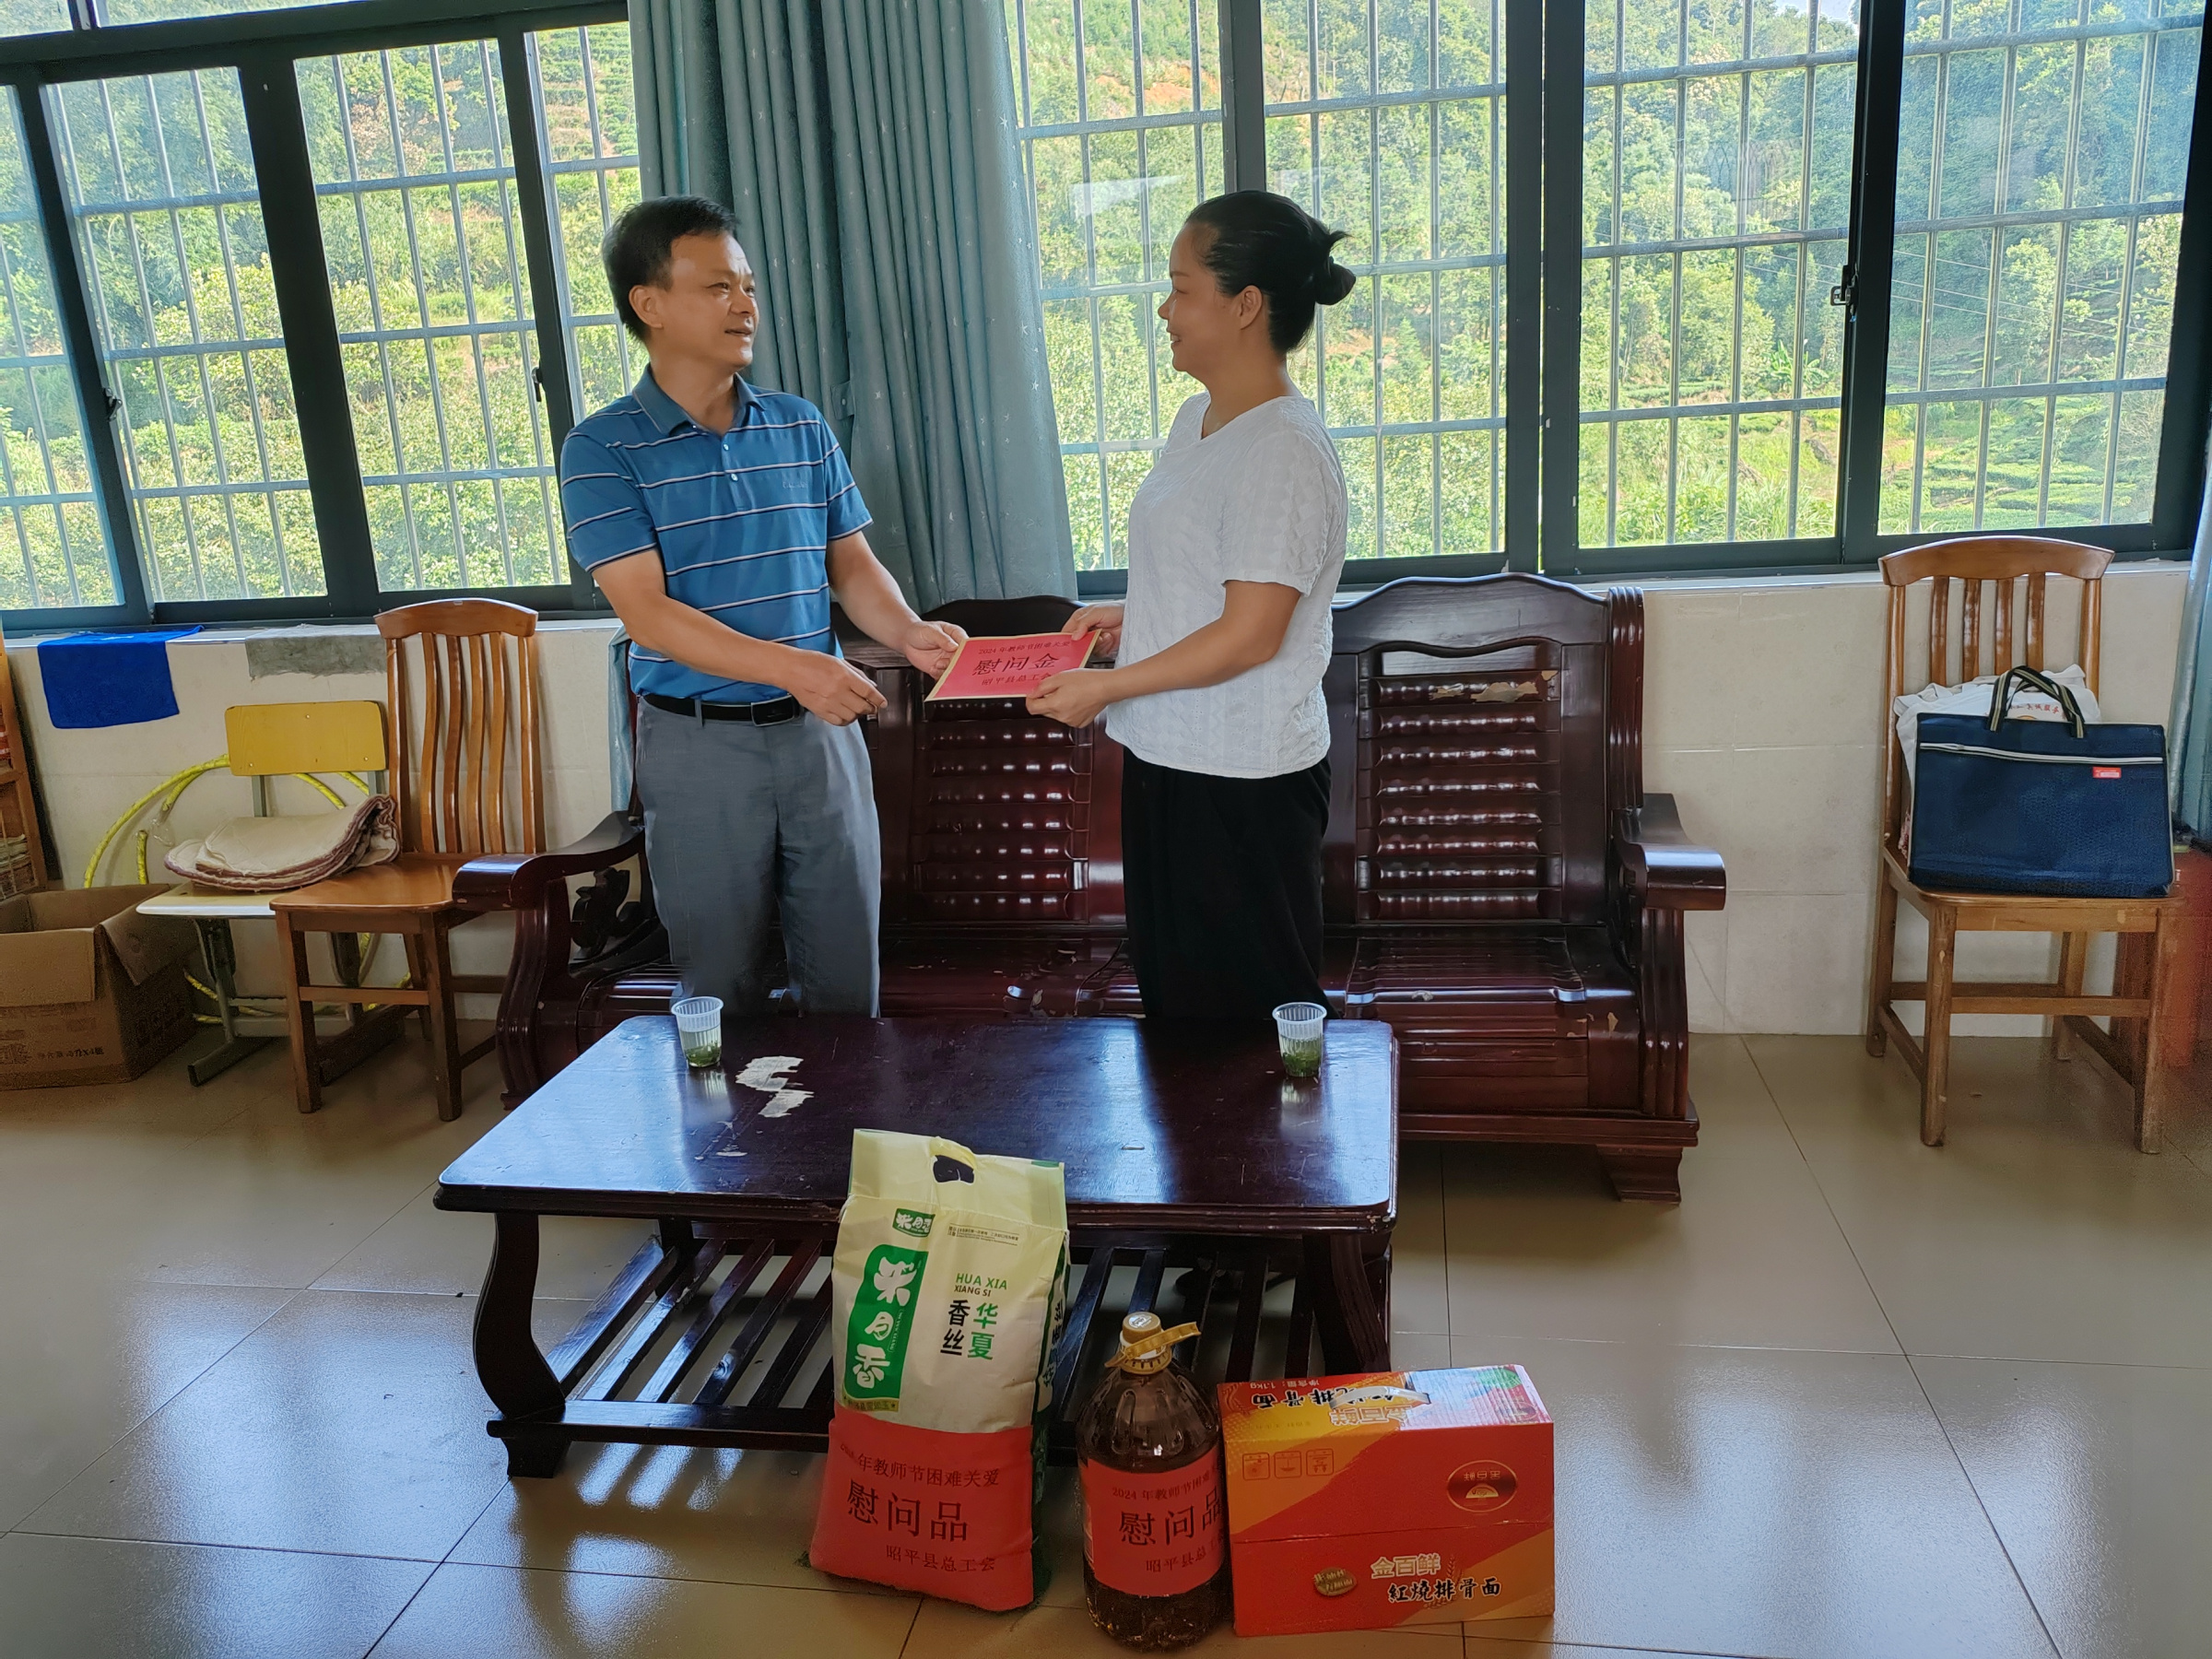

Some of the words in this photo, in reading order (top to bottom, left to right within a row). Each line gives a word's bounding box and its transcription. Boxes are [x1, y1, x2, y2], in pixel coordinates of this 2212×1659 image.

[971, 653, 1059, 676] 慰问金
[954, 1285, 981, 1297] XIANG
[982, 1288, 992, 1298] SI
[955, 1273, 982, 1287] HUA
[986, 1277, 1007, 1290] XIA
[939, 1299, 971, 1356] 香丝
[967, 1301, 999, 1360] 华夏
[1249, 1381, 1276, 1390] 1.1kg
[847, 1478, 968, 1542] 慰问品
[1119, 1485, 1220, 1546] 慰问品
[886, 1545, 995, 1572] 昭平县总工会
[1371, 1553, 1441, 1579] 金百鲜
